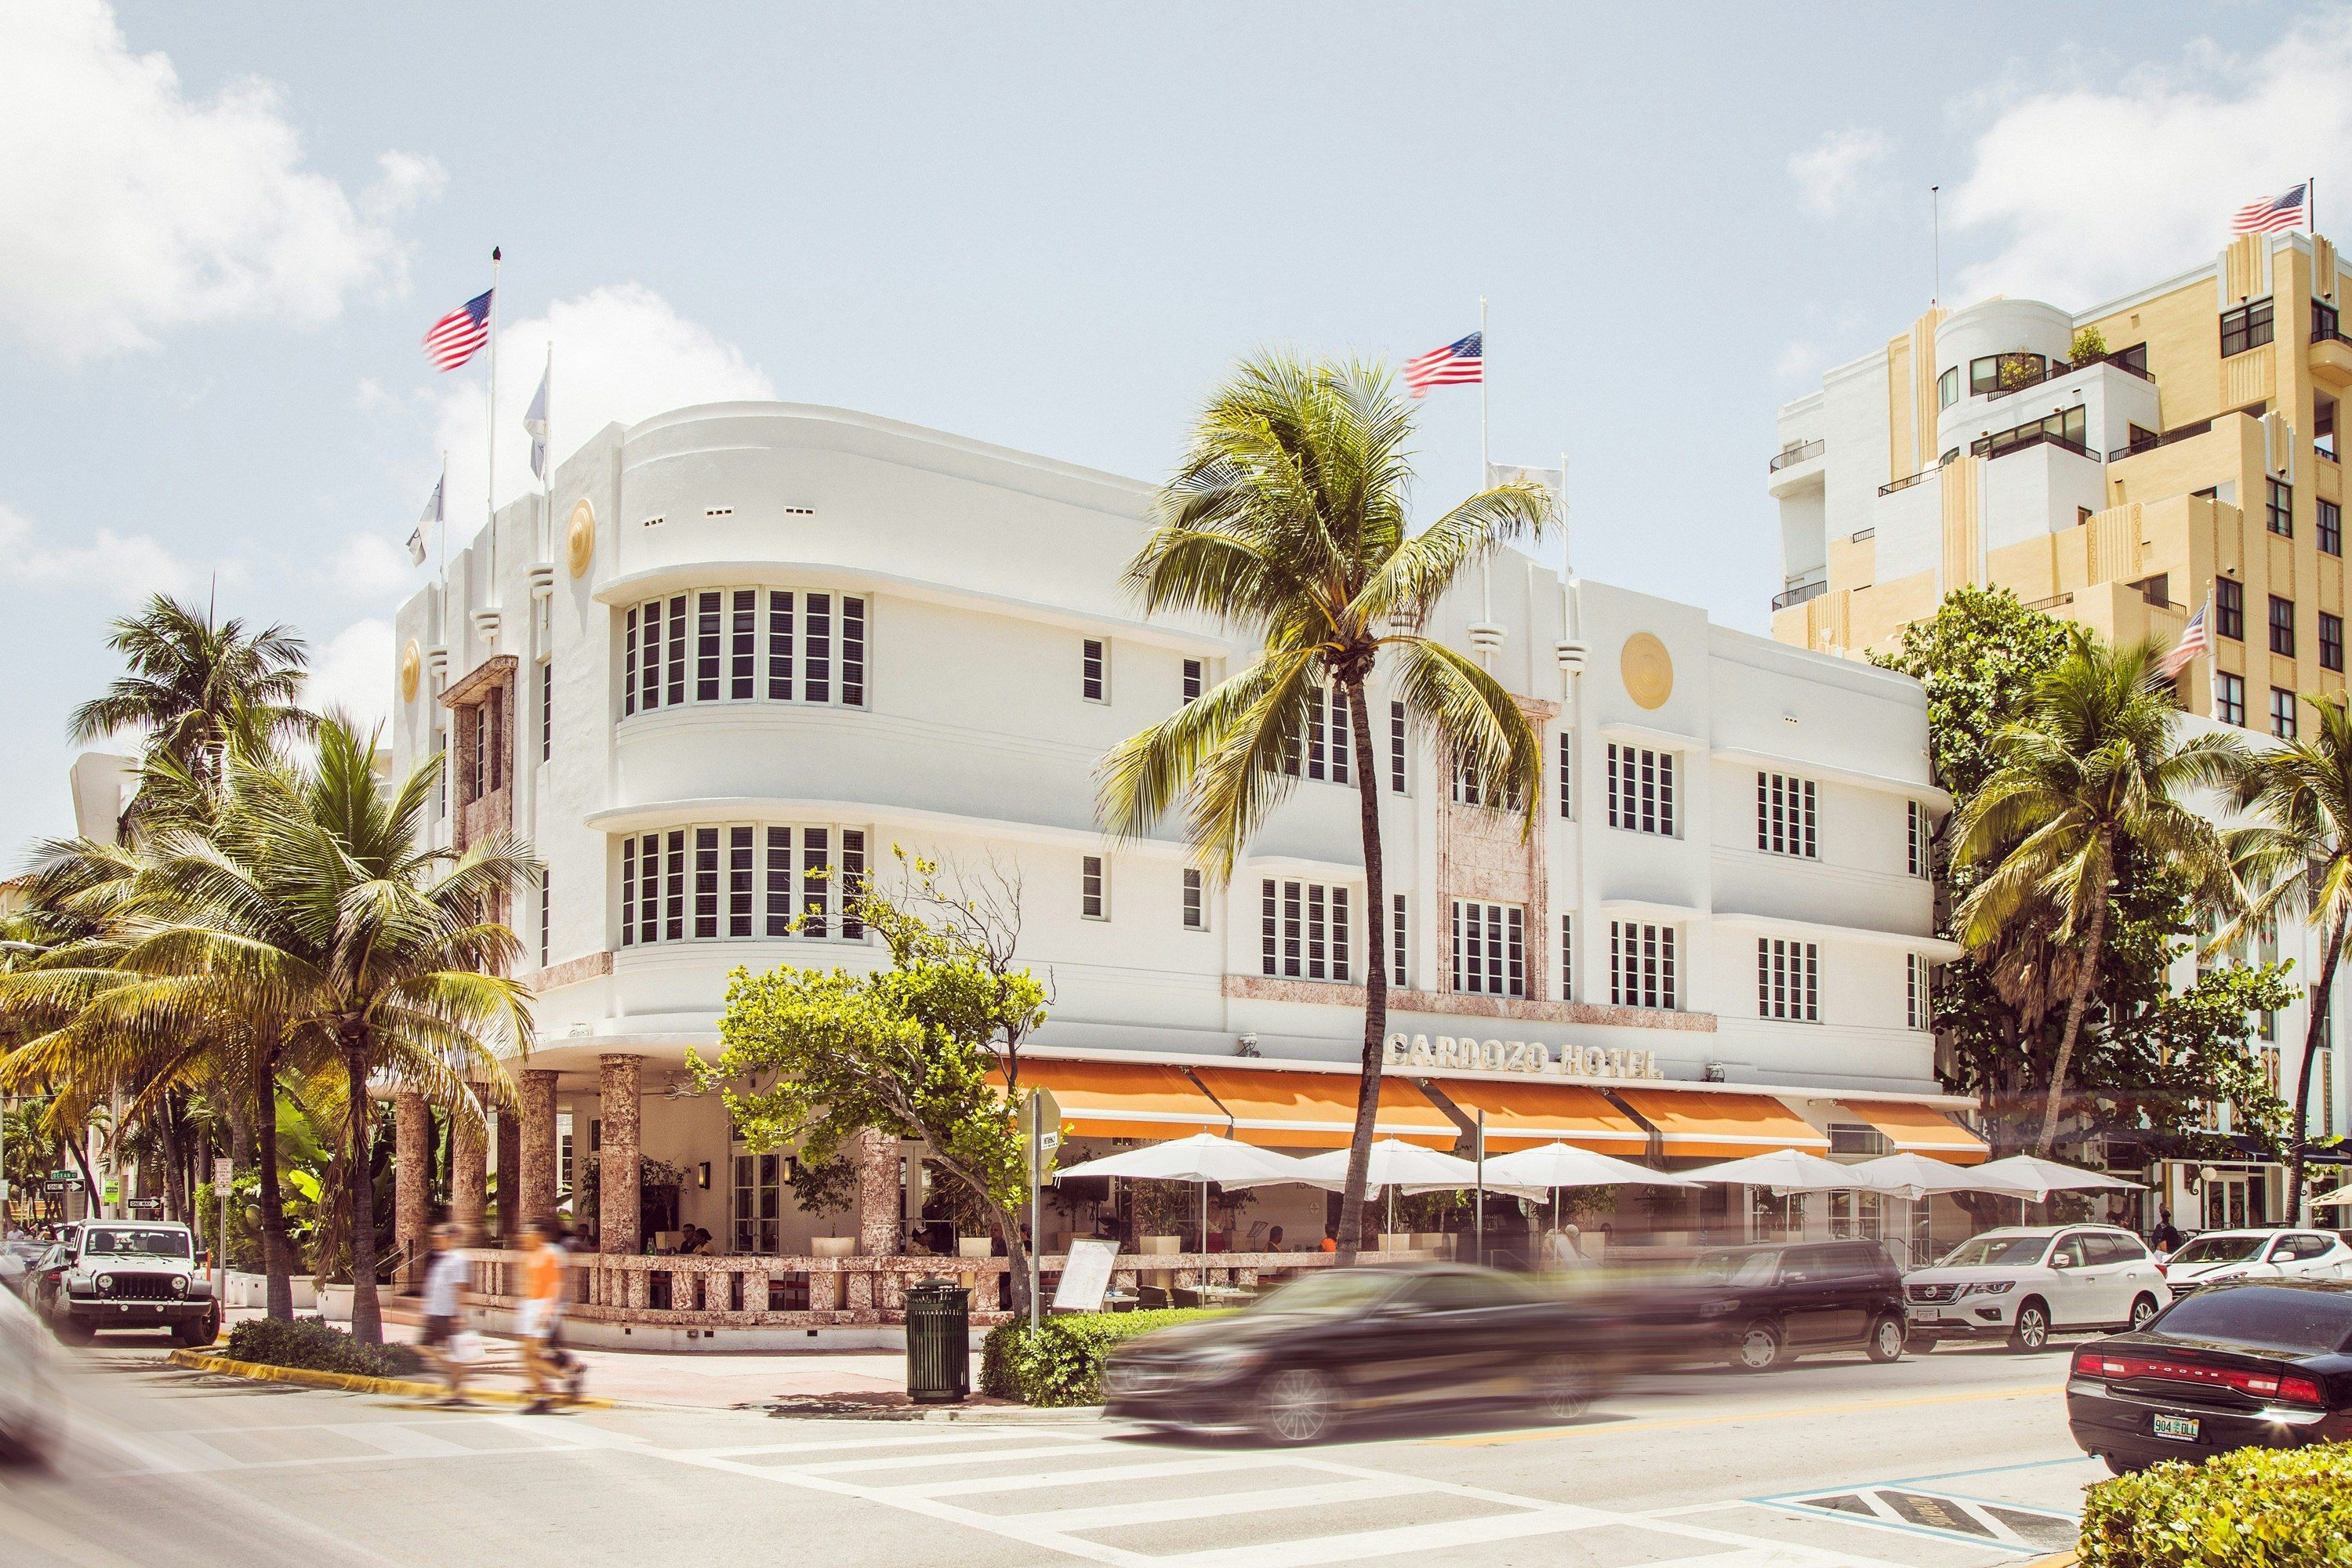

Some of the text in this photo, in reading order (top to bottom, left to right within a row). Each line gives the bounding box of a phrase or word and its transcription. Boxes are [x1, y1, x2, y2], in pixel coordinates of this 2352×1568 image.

[1384, 1033, 1664, 1080] CARDOZO HOTEL
[2149, 1365, 2218, 1377] DODGE
[2155, 1420, 2196, 1436] 904 DLL
